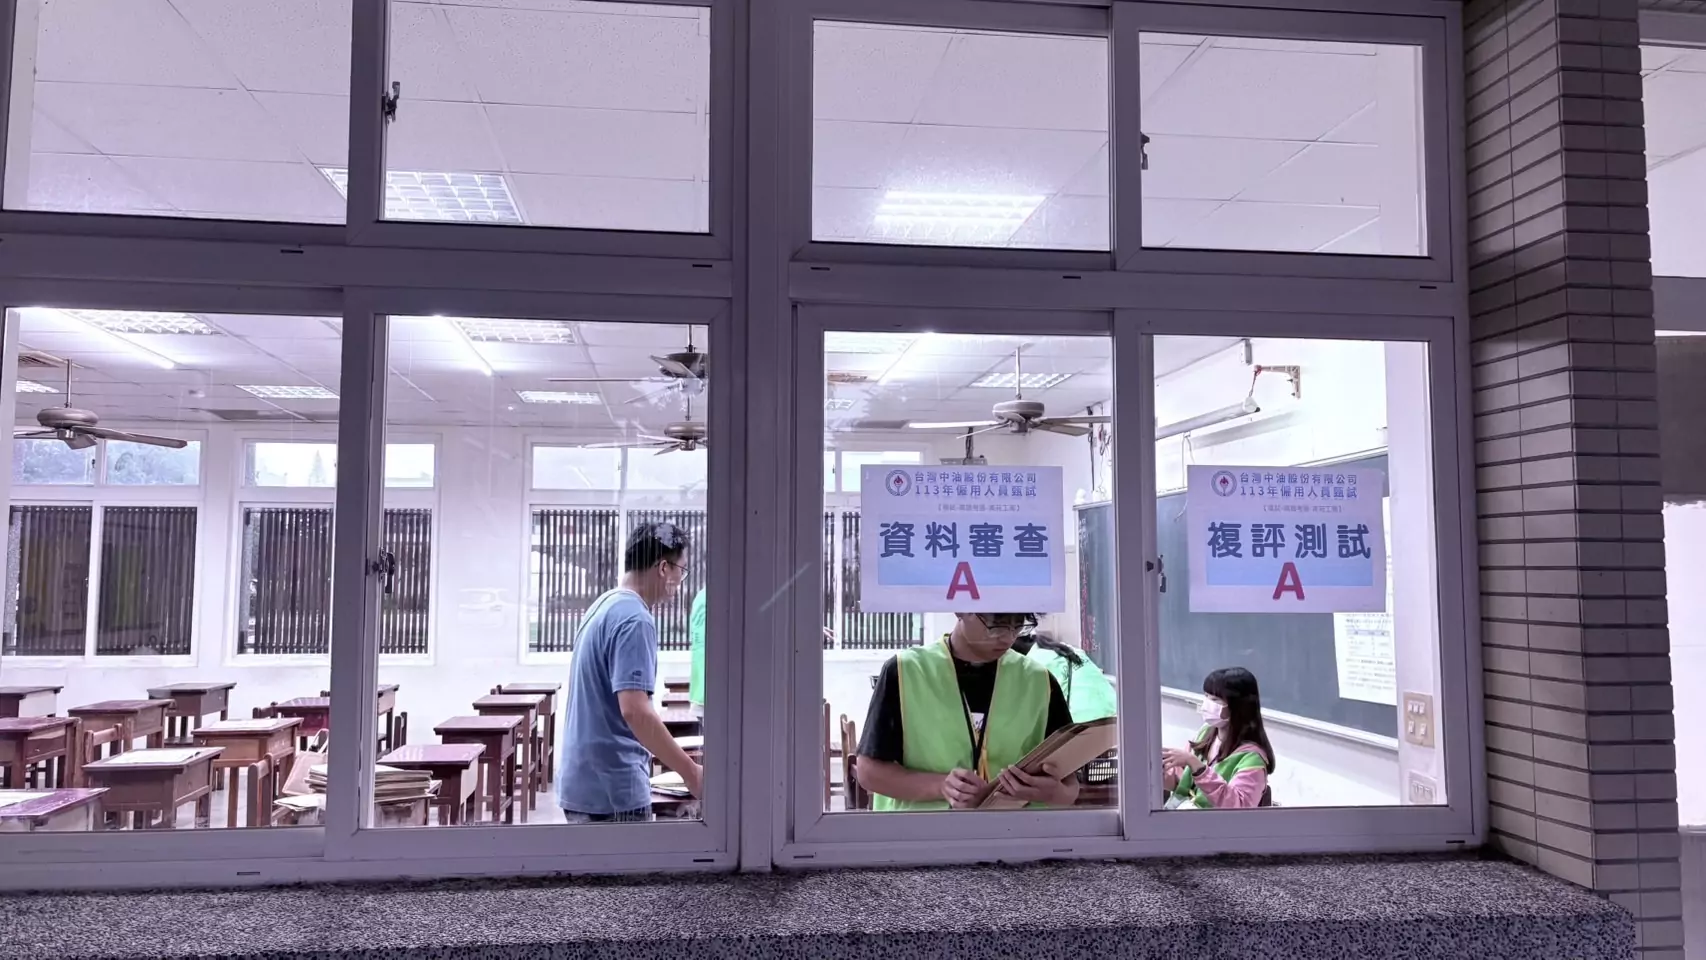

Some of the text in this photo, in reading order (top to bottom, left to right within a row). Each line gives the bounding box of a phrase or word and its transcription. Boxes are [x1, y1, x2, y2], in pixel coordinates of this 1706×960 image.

[915, 472, 1037, 483] 台灣中油股份有限公司
[1240, 473, 1357, 485] 台灣中油股份有限公司
[880, 521, 1048, 558] 資料審查
[1207, 521, 1371, 559] 複評測試
[946, 561, 980, 600] A
[1272, 562, 1305, 600] A
